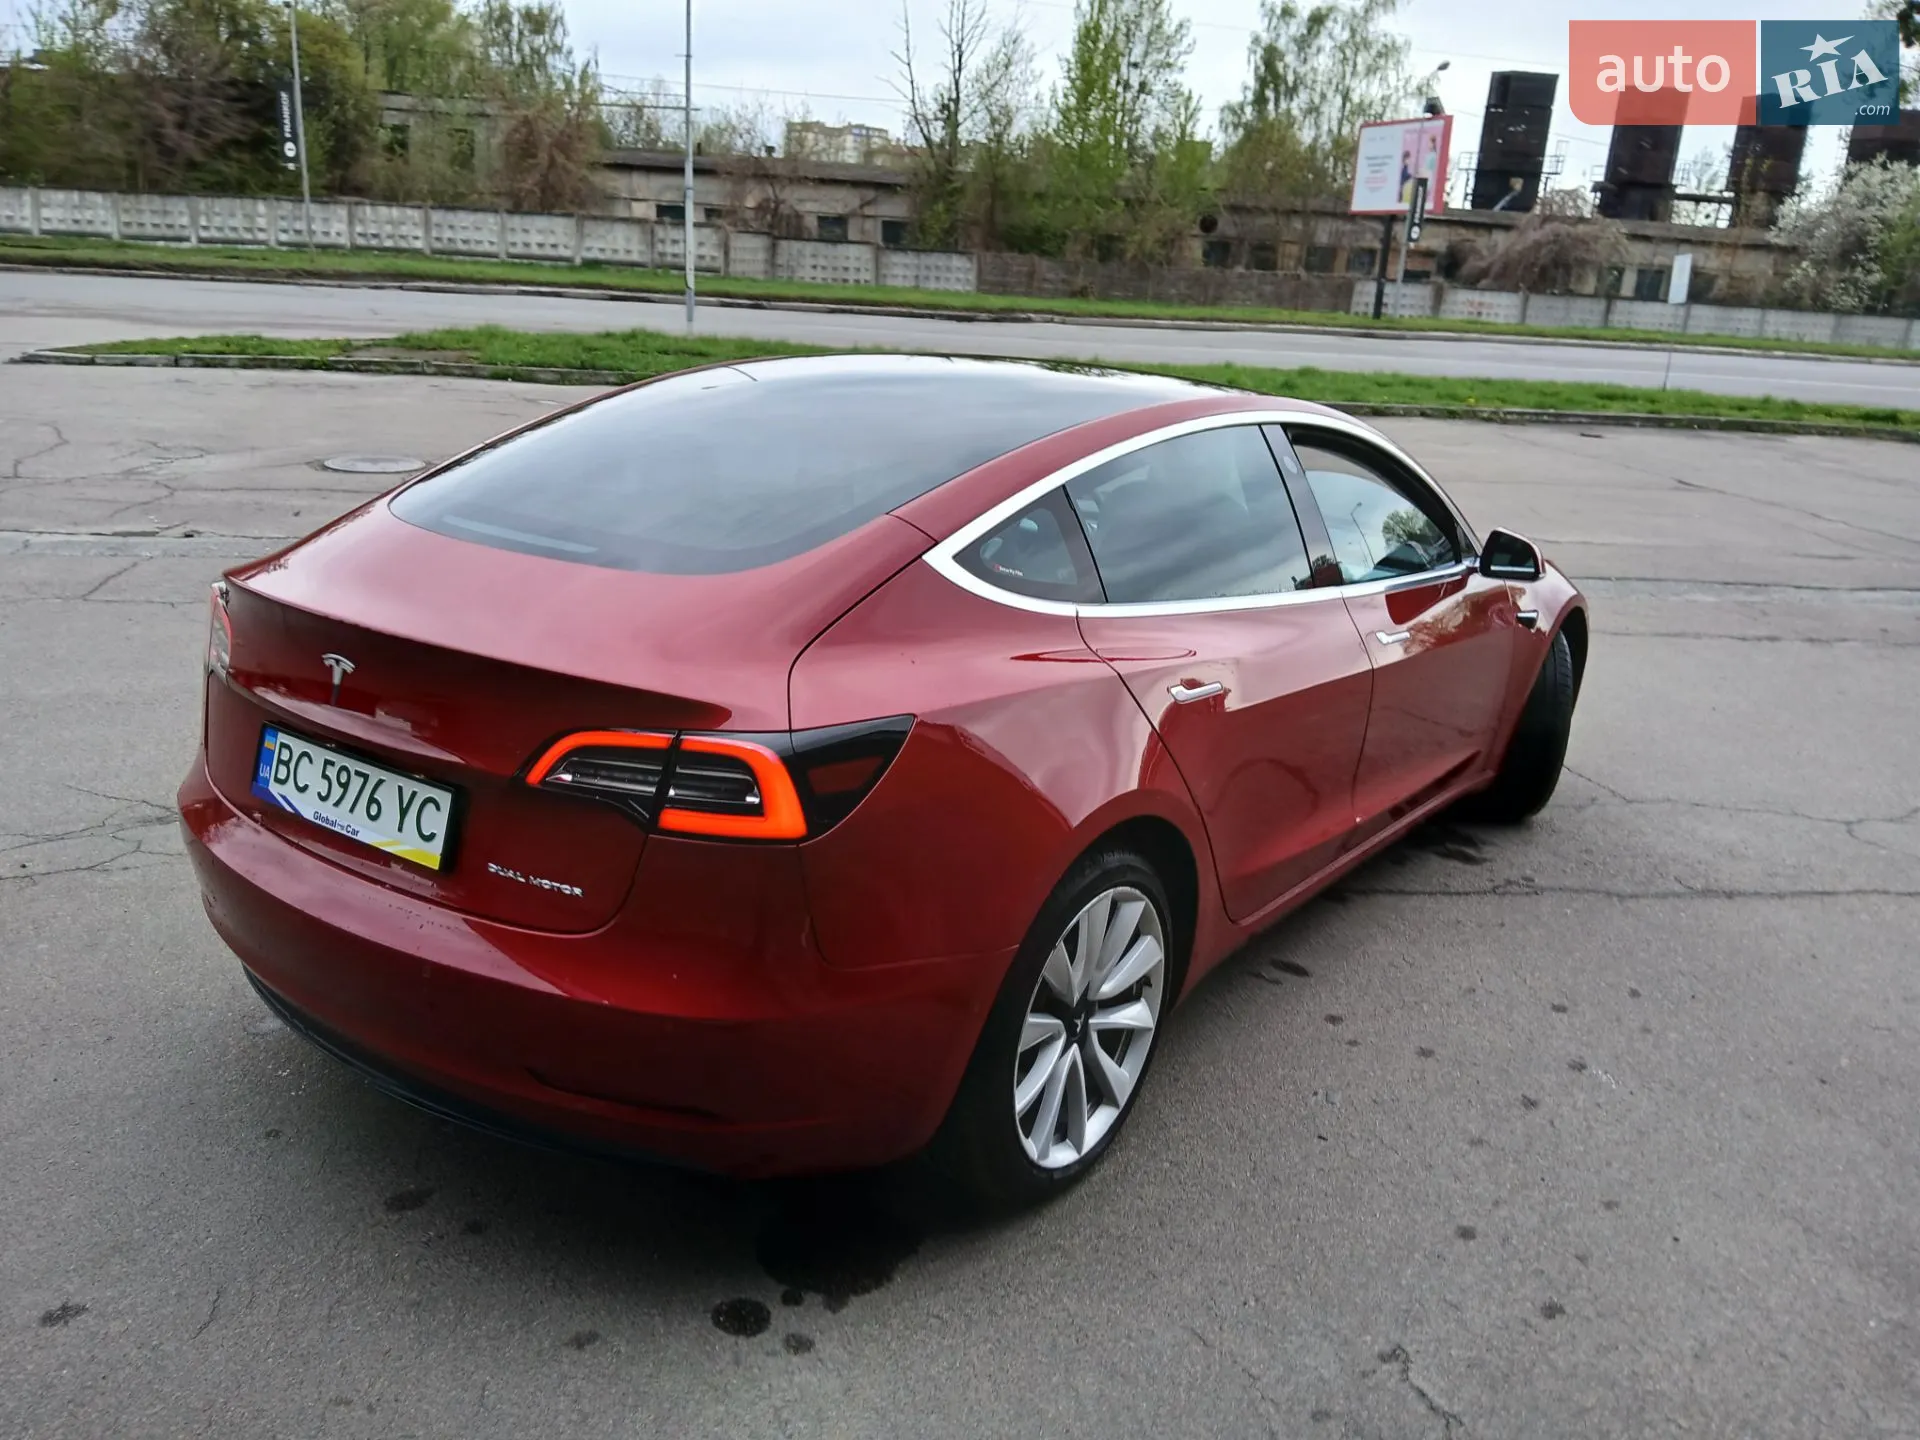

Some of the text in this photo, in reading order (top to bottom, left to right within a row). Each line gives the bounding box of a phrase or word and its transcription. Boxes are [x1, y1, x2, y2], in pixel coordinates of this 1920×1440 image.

[259, 763, 271, 778] UA
[273, 741, 442, 842] BC 5976 YC
[313, 810, 338, 829] Global
[345, 824, 360, 837] Car
[488, 862, 584, 898] DUAL MOTOR
